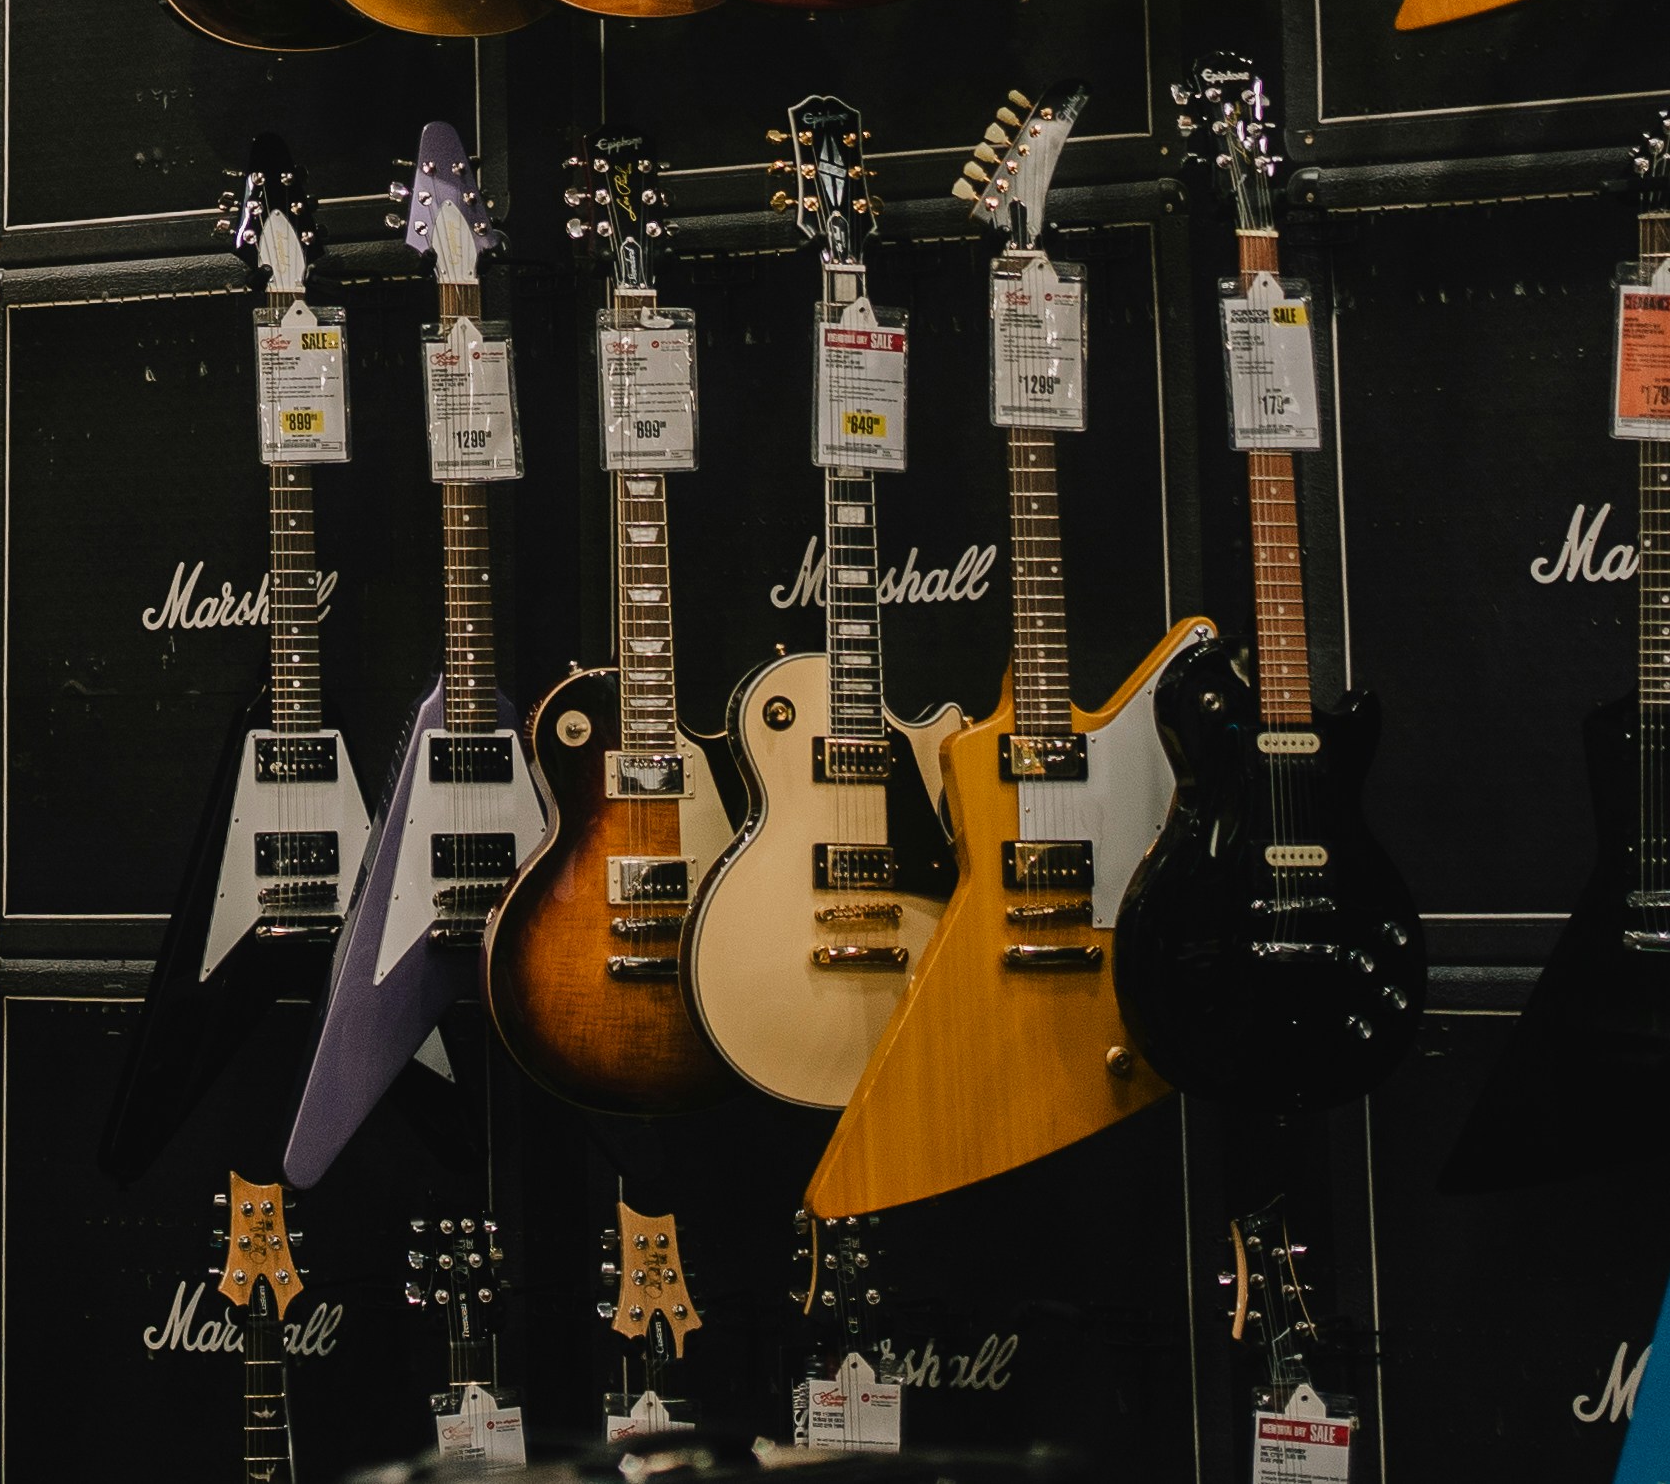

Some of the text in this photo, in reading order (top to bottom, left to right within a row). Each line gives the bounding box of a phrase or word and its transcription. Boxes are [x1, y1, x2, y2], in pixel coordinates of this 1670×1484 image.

[1273, 307, 1297, 325] SALE
[302, 333, 327, 350] SALE
[869, 332, 894, 350] SALE
[1309, 1424, 1335, 1444] SALE
